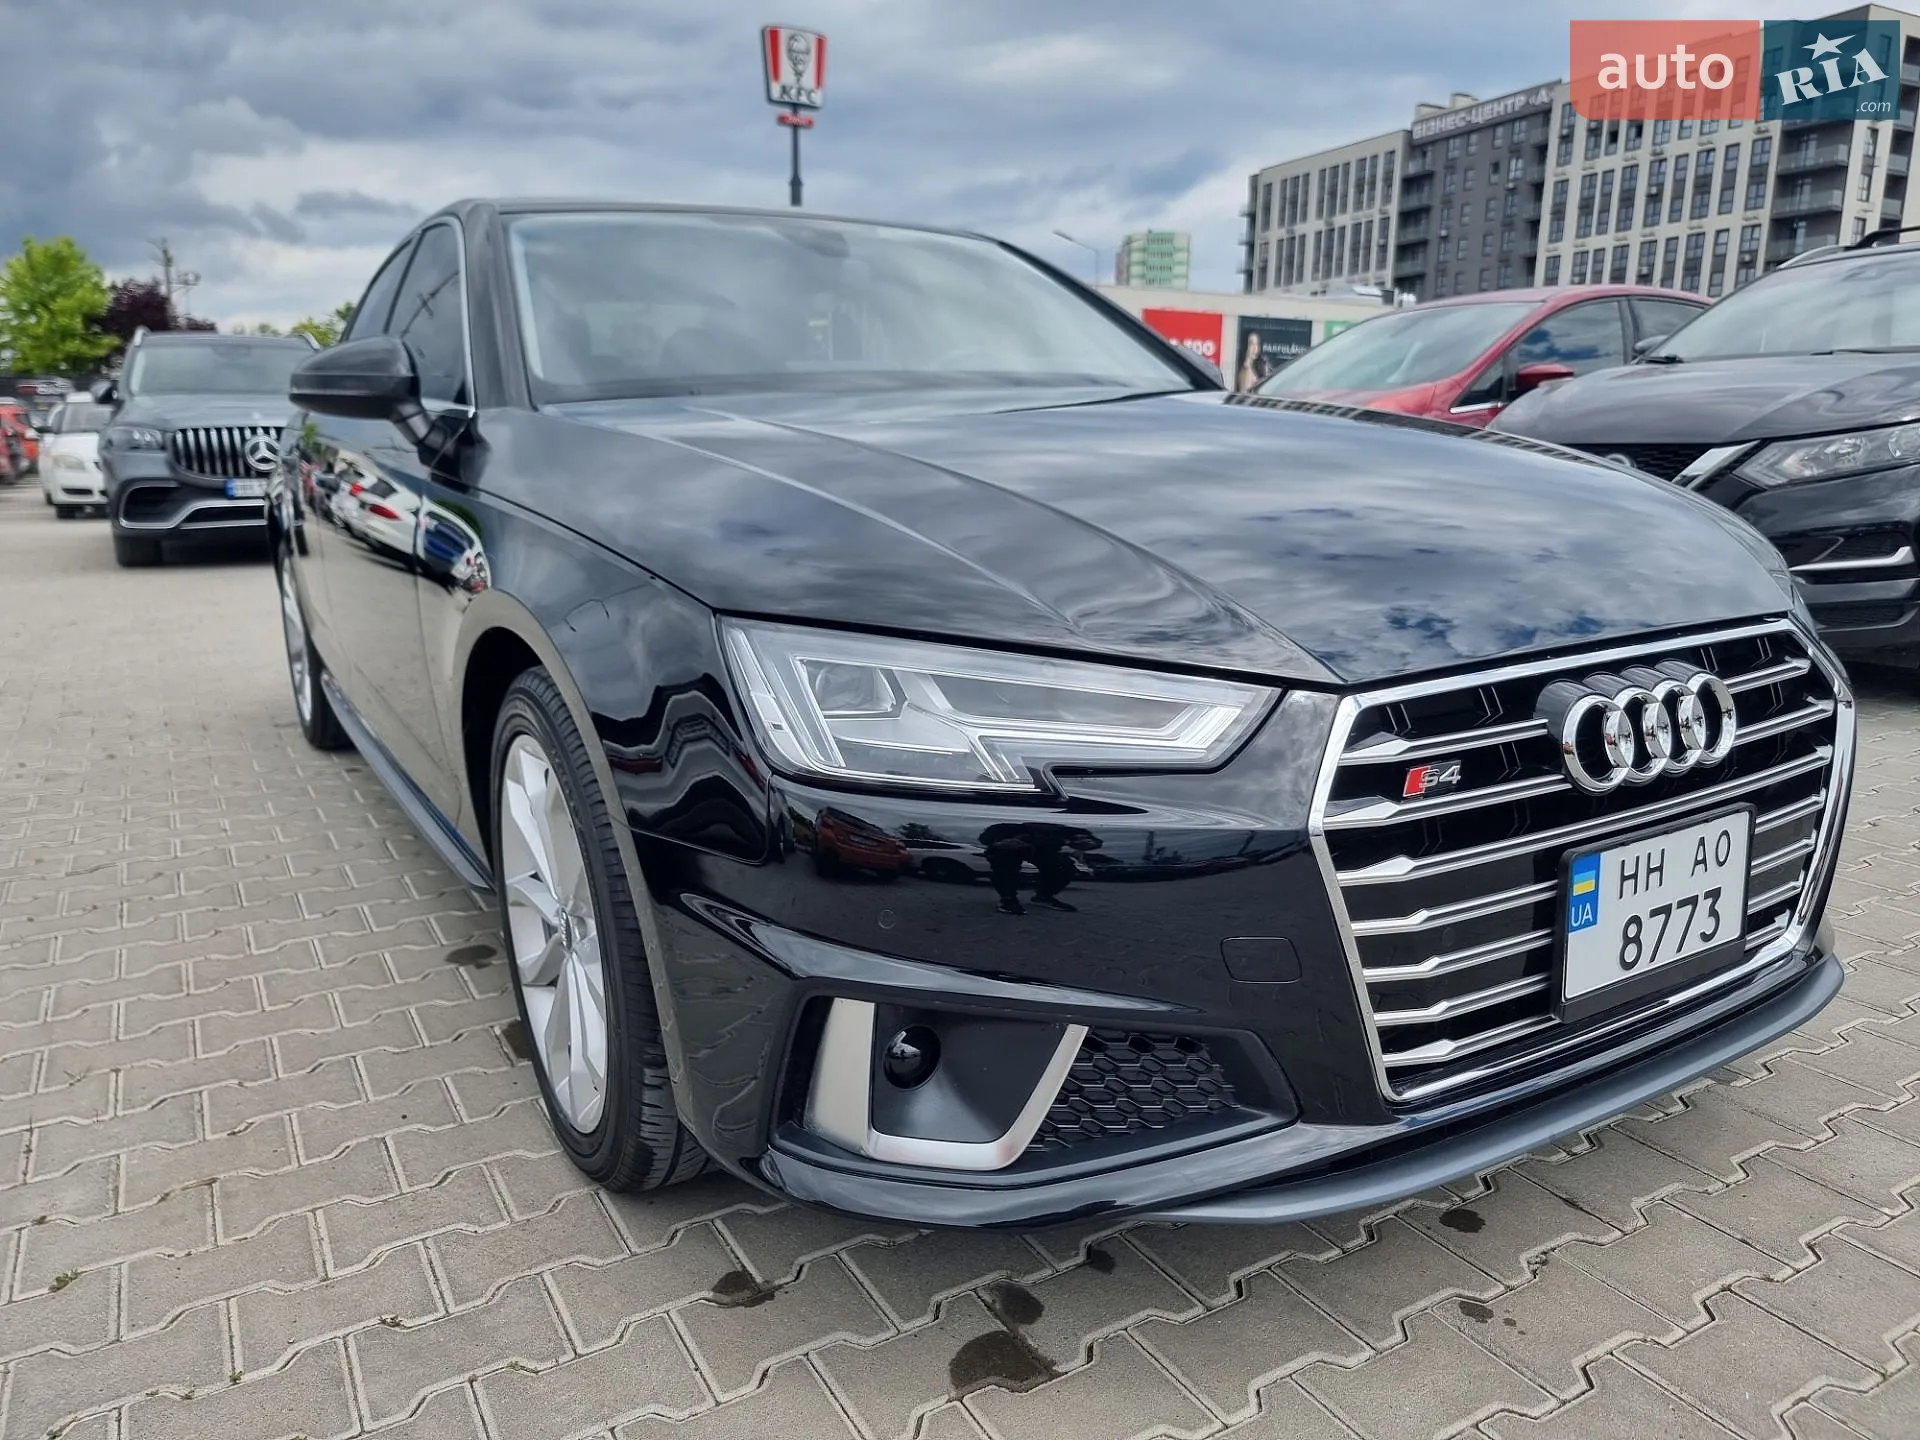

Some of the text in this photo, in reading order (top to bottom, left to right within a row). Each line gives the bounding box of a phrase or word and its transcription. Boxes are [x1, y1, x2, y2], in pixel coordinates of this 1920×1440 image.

[780, 84, 818, 105] KFC
[1618, 848, 1666, 900] HH
[1570, 902, 1593, 927] UA
[1619, 886, 1722, 971] 8773
